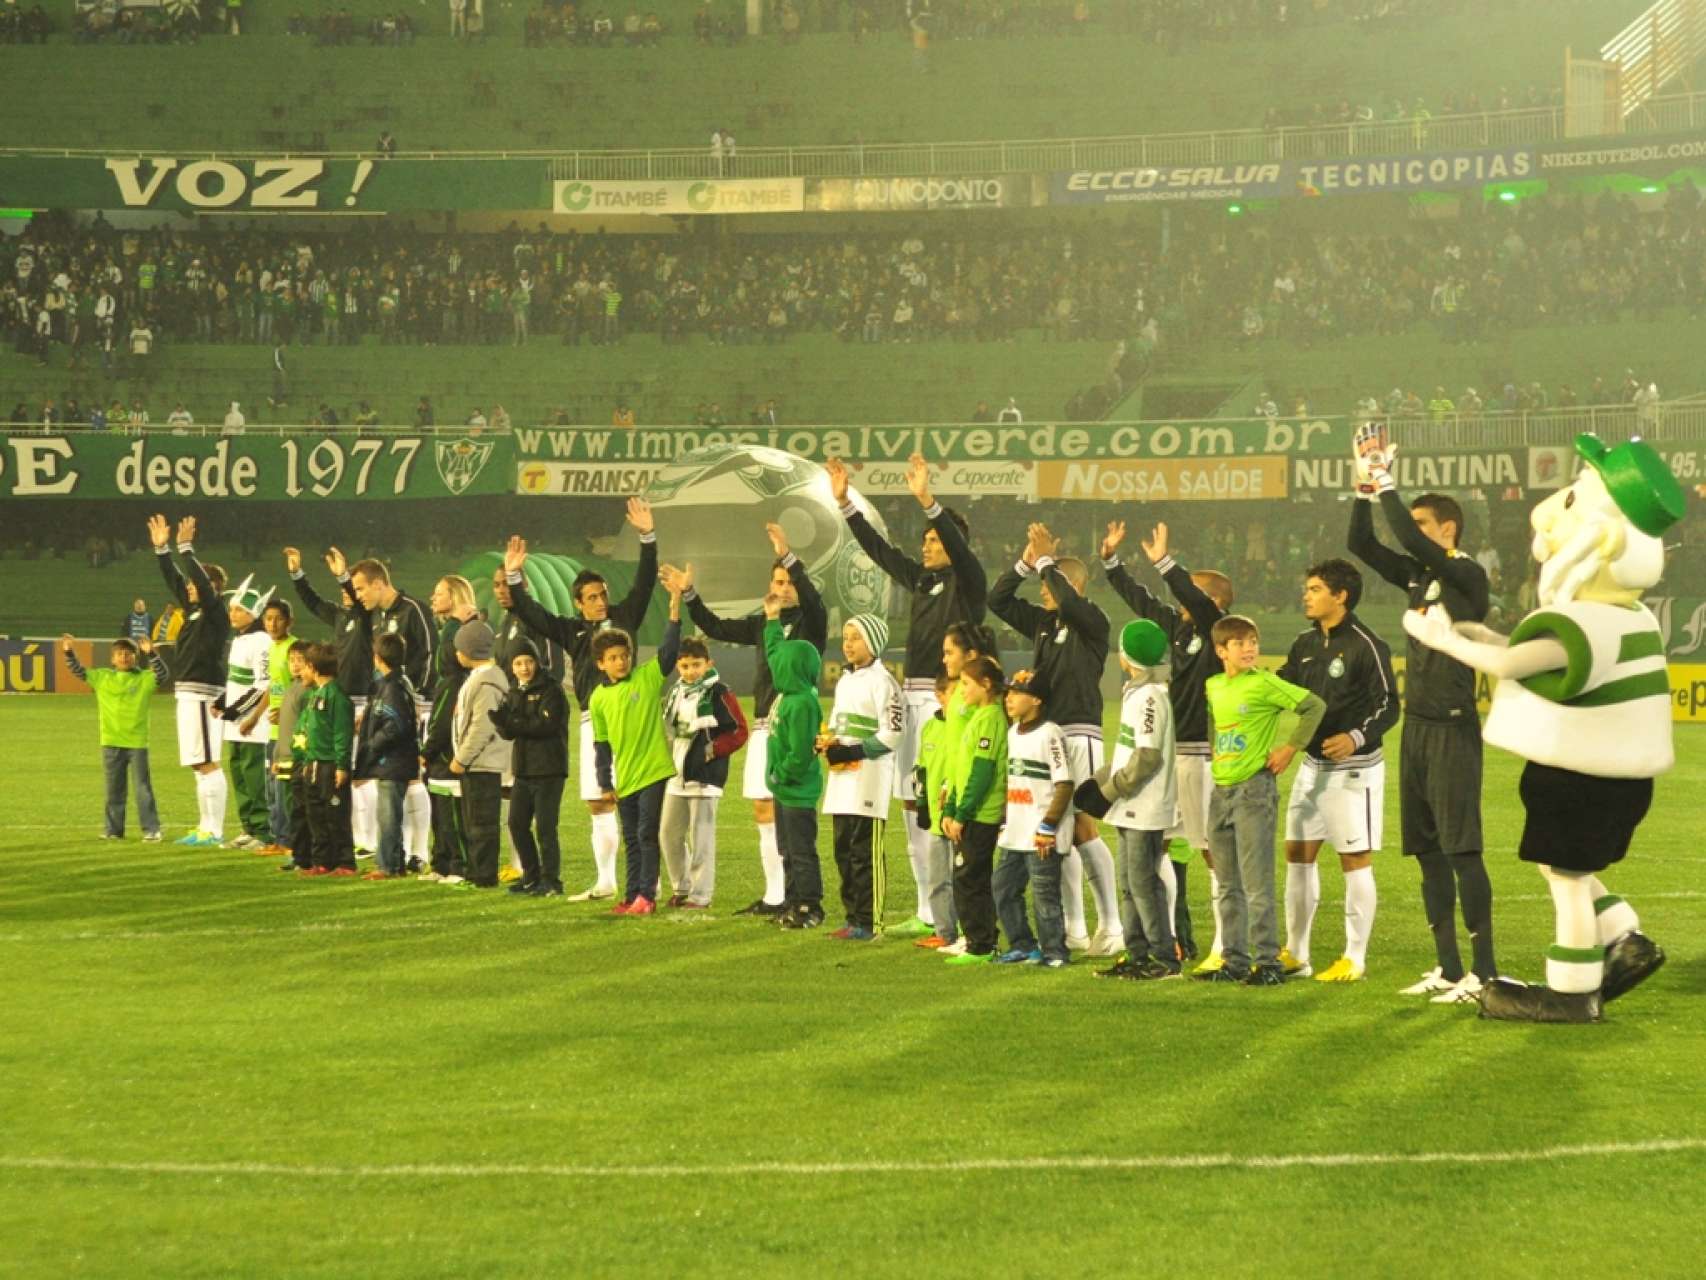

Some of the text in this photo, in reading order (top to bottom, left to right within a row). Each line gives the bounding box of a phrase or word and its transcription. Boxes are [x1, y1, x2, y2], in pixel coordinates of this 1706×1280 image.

[1301, 152, 1530, 188] TECNICOPIAS
[595, 188, 668, 207] ITAMBÉ
[720, 187, 791, 206] ITAMBÉ
[875, 179, 1002, 202] UNIODONTO
[0, 437, 422, 498] E desde 1977
[952, 469, 1025, 490] Expoente
[1061, 462, 1264, 496] NOSSA SAÚDE
[1295, 454, 1519, 488] NUTILATINA
